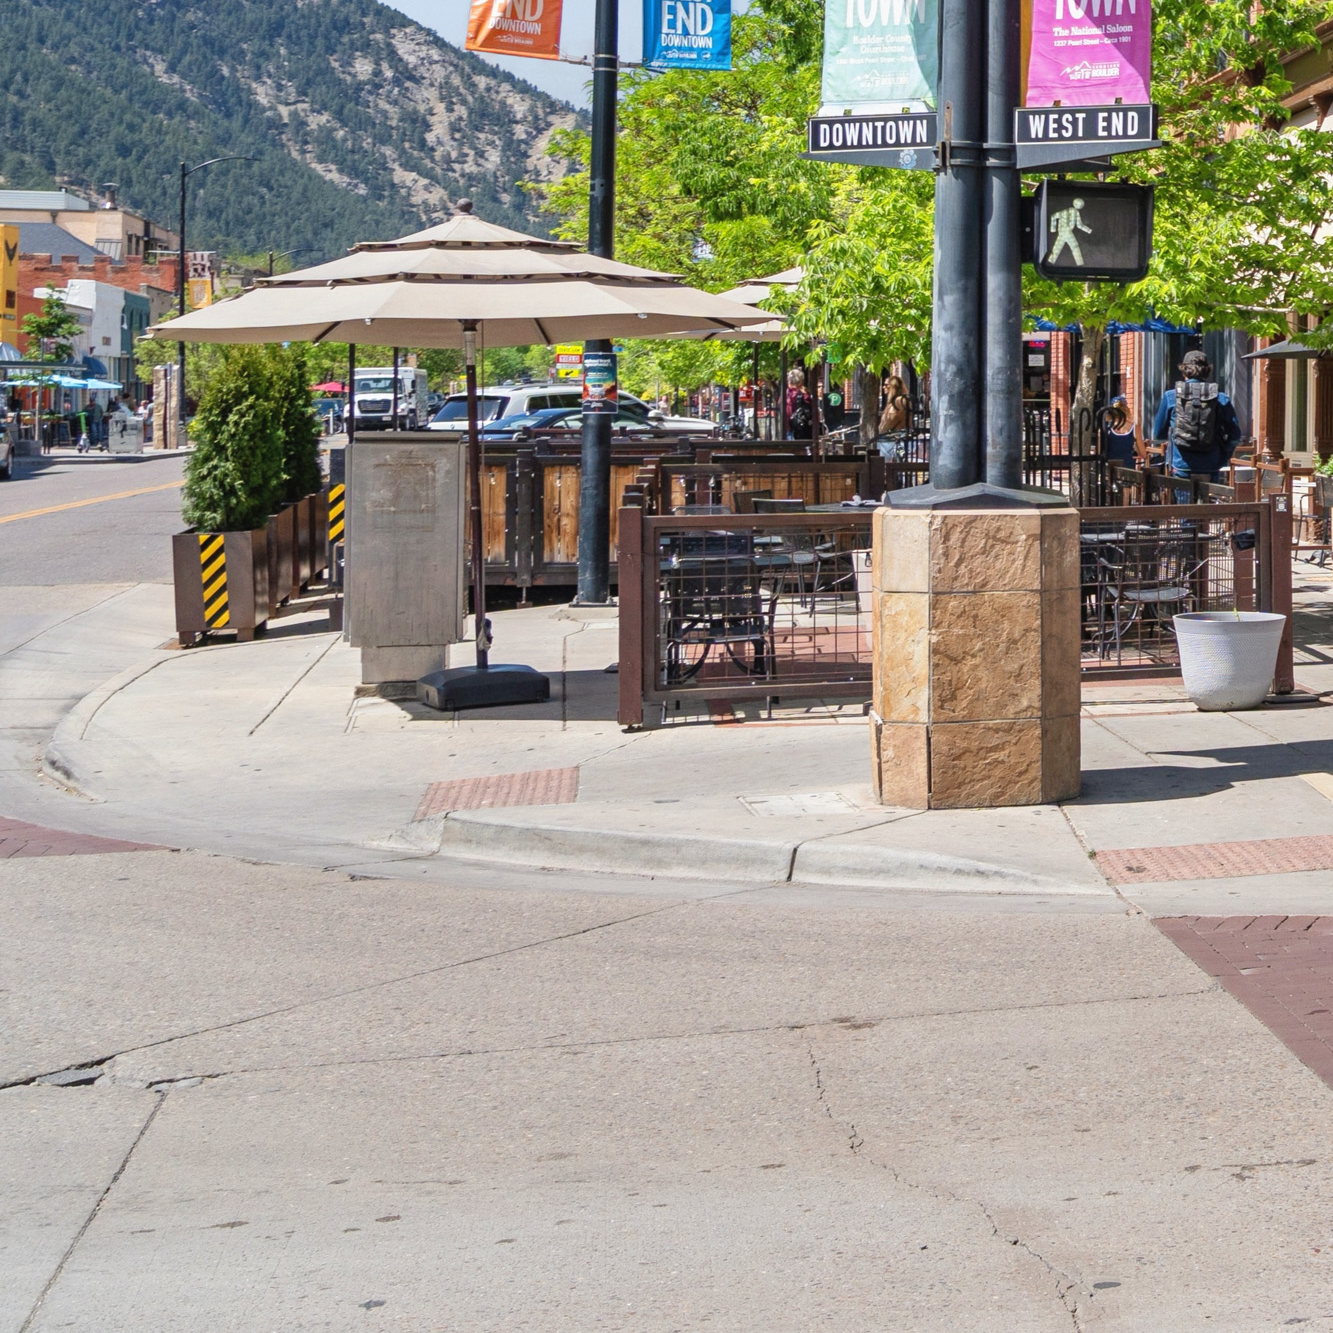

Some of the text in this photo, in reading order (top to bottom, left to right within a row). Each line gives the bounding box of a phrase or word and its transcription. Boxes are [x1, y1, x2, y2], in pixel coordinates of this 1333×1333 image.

[488, 17, 542, 35] DOWNTOWN
[661, 0, 713, 36] END
[1106, 24, 1133, 34] Saloon
[661, 34, 713, 49] DOWNTOWN
[819, 119, 928, 148] DOWNTOWN
[1029, 111, 1139, 139] WEST END
